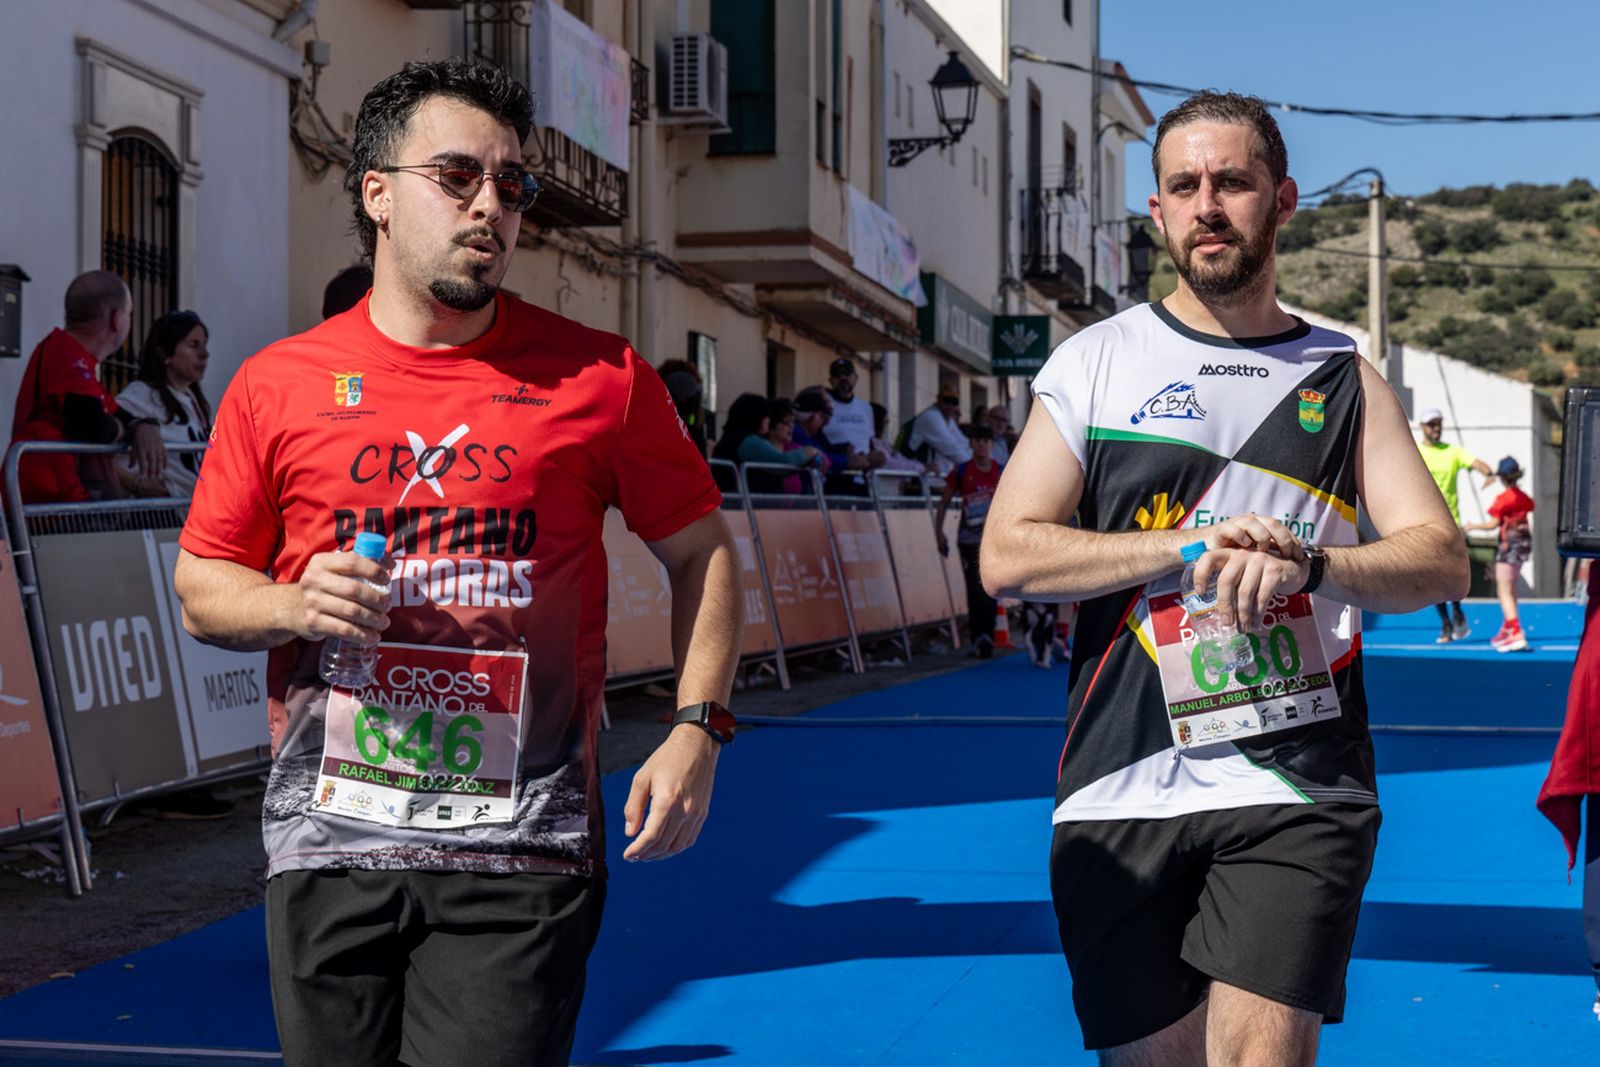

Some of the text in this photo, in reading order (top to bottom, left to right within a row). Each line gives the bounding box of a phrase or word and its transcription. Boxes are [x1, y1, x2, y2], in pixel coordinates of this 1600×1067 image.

[1198, 363, 1270, 378] Mosttro
[350, 443, 518, 484] CROSS
[334, 507, 538, 557] PANTANO
[61, 615, 162, 712] UNED
[387, 665, 491, 697] CROSS
[203, 668, 260, 712] MARTOS
[352, 688, 488, 717] PANTANO DEL
[1169, 696, 1217, 715] MANUEL
[354, 706, 485, 776] 646
[338, 763, 393, 785] RAFAEL
